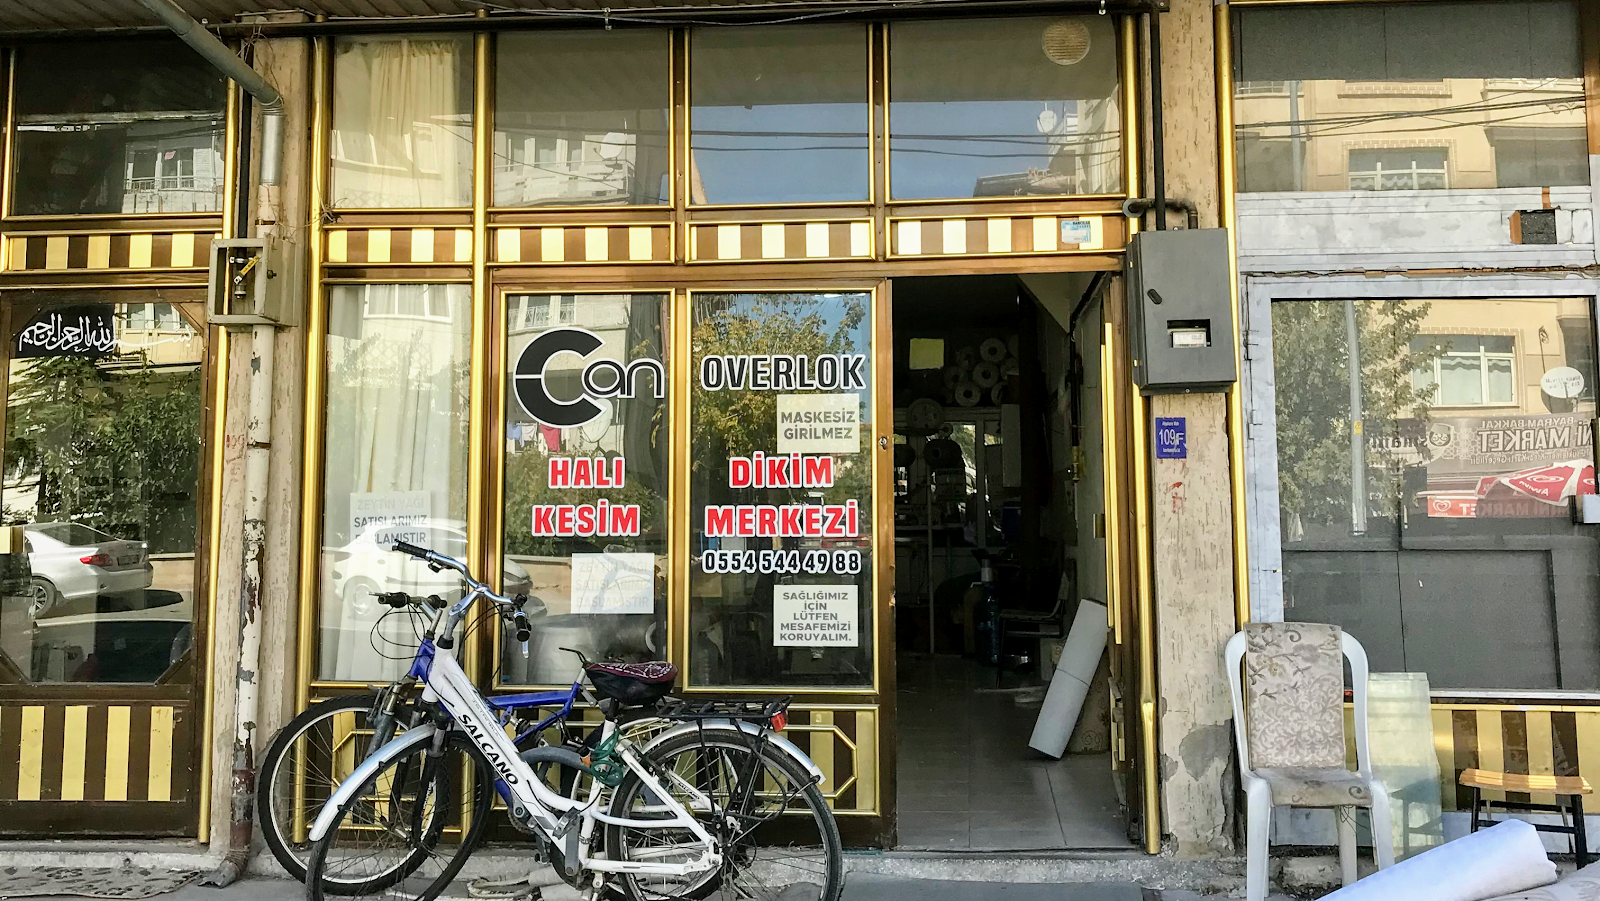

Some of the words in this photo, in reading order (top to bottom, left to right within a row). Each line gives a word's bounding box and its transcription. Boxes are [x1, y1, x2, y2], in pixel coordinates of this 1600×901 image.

[513, 327, 665, 428] Can
[701, 354, 867, 391] OVERLOK
[781, 408, 856, 424] MASKESİZ
[783, 425, 853, 440] GİRİLMEZ
[548, 457, 625, 490] HALI
[729, 451, 835, 489] DİKİM
[532, 499, 641, 537] KESİM
[704, 499, 859, 537] MERKEZİ
[702, 549, 757, 574] 0554
[759, 549, 801, 574] 544
[782, 590, 849, 600] SAĞLIĞIMIZ
[804, 601, 827, 612] İÇİN
[780, 621, 851, 631] MESAFEMİZİ
[793, 611, 838, 621] LÜTFEN
[780, 633, 852, 642] KORUYALIM.
[457, 714, 519, 786] SALCANO
